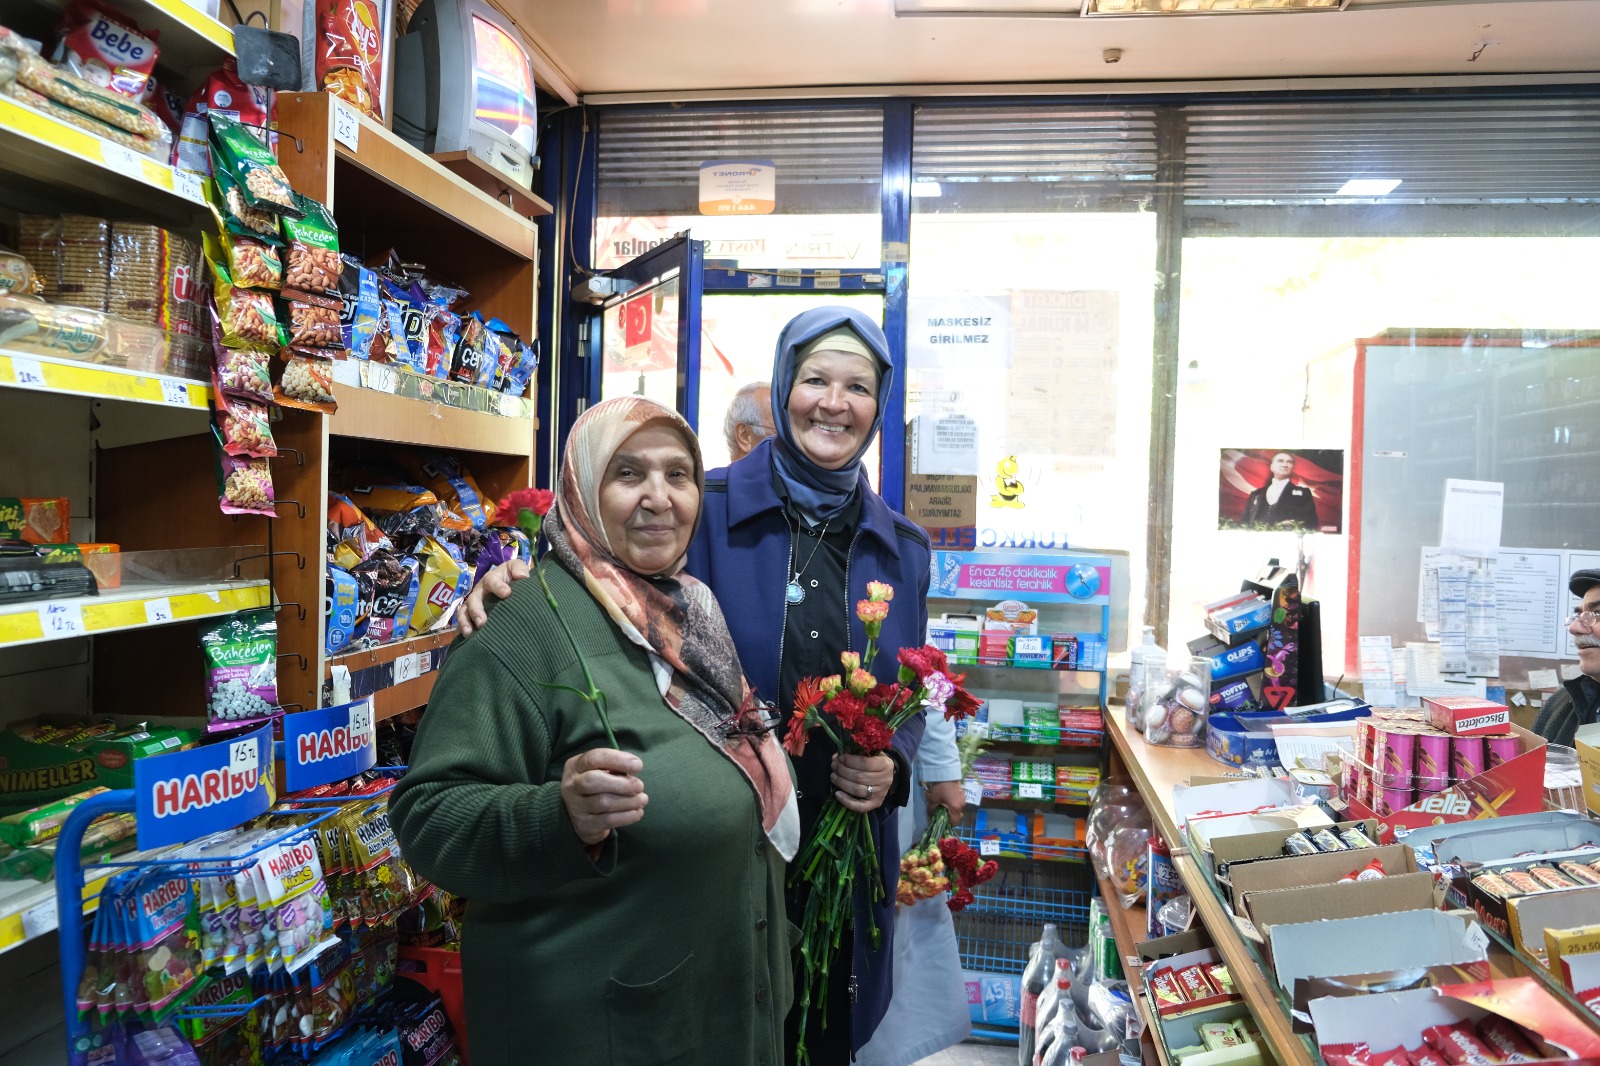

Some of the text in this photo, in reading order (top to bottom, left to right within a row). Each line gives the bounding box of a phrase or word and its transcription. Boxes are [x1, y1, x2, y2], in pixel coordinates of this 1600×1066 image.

[91, 20, 144, 60] Bebe
[287, 222, 336, 243] Bahçeden
[927, 316, 992, 327] MASKESİZ
[55, 325, 98, 346] halley
[929, 334, 989, 344] GİRİLMEZ
[377, 369, 390, 390] 18
[969, 566, 1058, 579] En az 45 dakikalık
[969, 577, 1053, 590] kesintisiz ferahlık
[51, 617, 64, 631] 12
[1233, 617, 1250, 633] First
[211, 641, 273, 665] Bahçeden
[1019, 652, 1047, 660] VIVIDENT
[399, 657, 411, 680] 18
[353, 713, 361, 731] 15
[1458, 712, 1506, 730] Biscolata
[235, 744, 247, 762] 15
[155, 766, 259, 817] HARIBO
[357, 813, 389, 844] HARIBO
[268, 844, 313, 877] HARIBO
[143, 877, 188, 917] HARIBO
[1568, 944, 1581, 954] 25
[985, 981, 1005, 1002] 45
[408, 1010, 445, 1050] HARIBO
